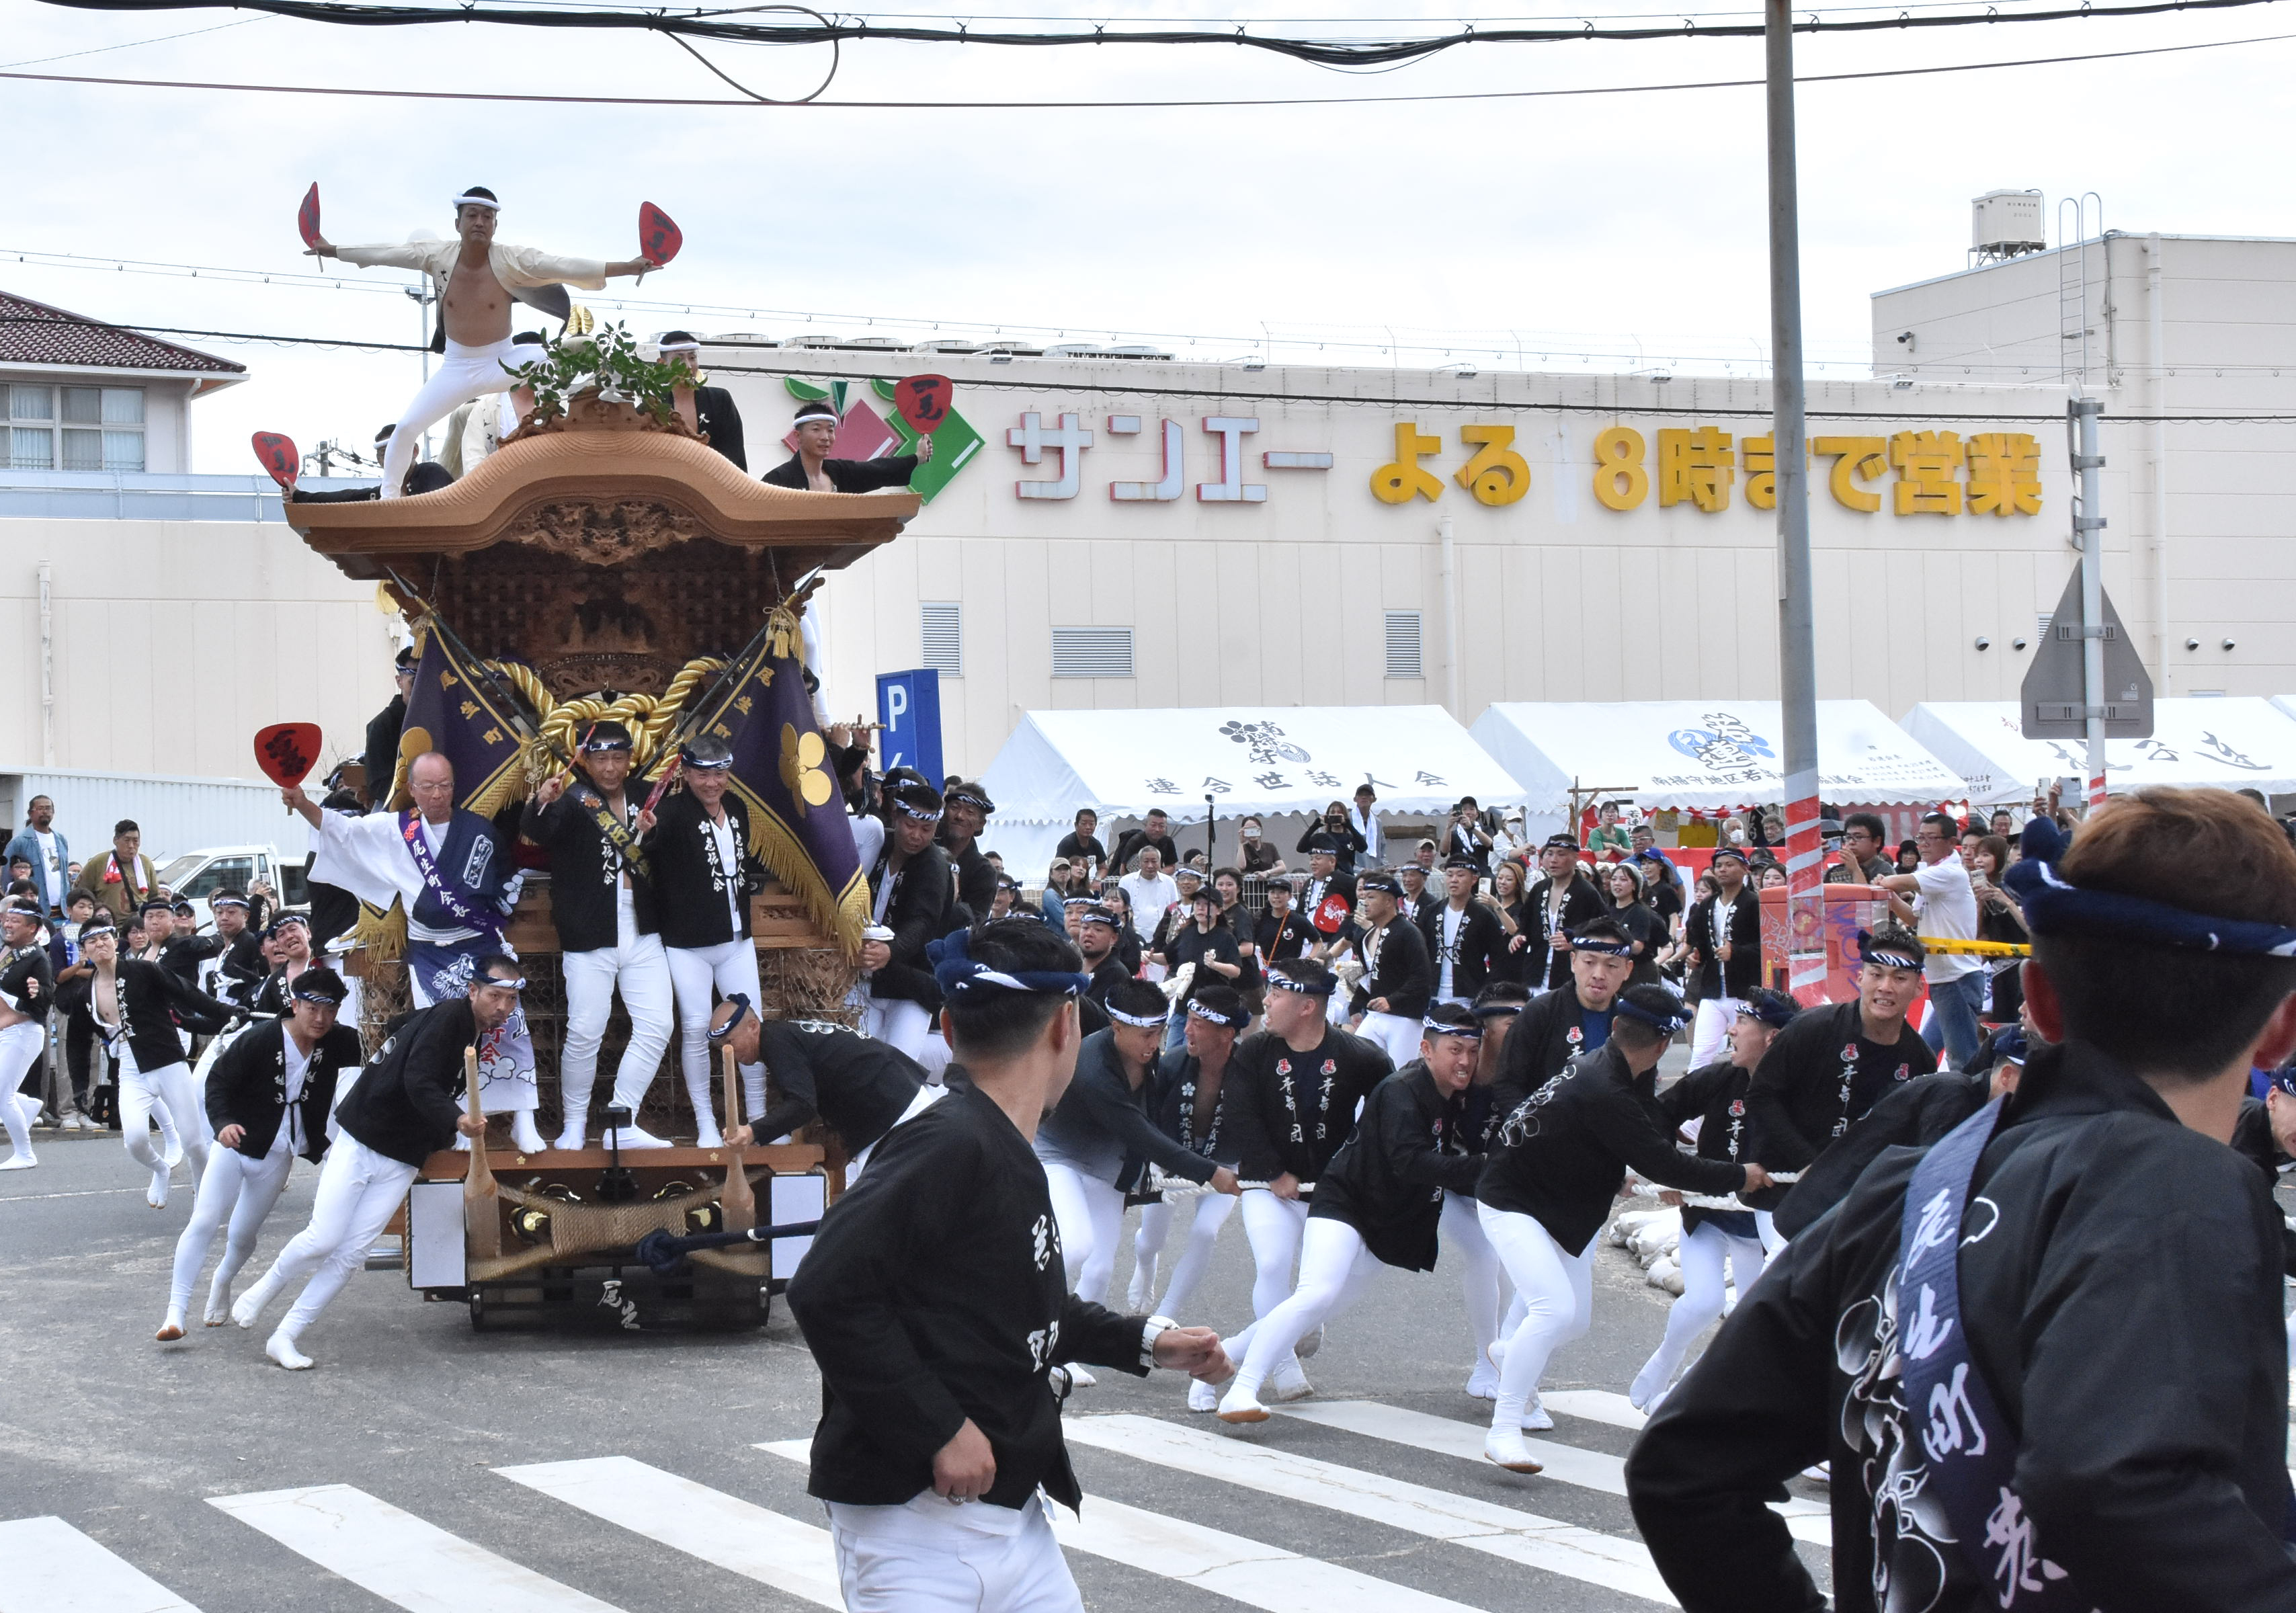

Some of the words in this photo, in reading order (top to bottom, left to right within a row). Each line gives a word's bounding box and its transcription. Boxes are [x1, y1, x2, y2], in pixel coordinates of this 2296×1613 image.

[1006, 412, 1334, 503] サンエー
[1369, 423, 1530, 506] よる
[887, 685, 907, 732] P
[1145, 770, 1448, 795] 連合世話人会
[1651, 768, 1866, 787] 南掃守地区若協議会
[413, 839, 470, 917] 尾生町会長
